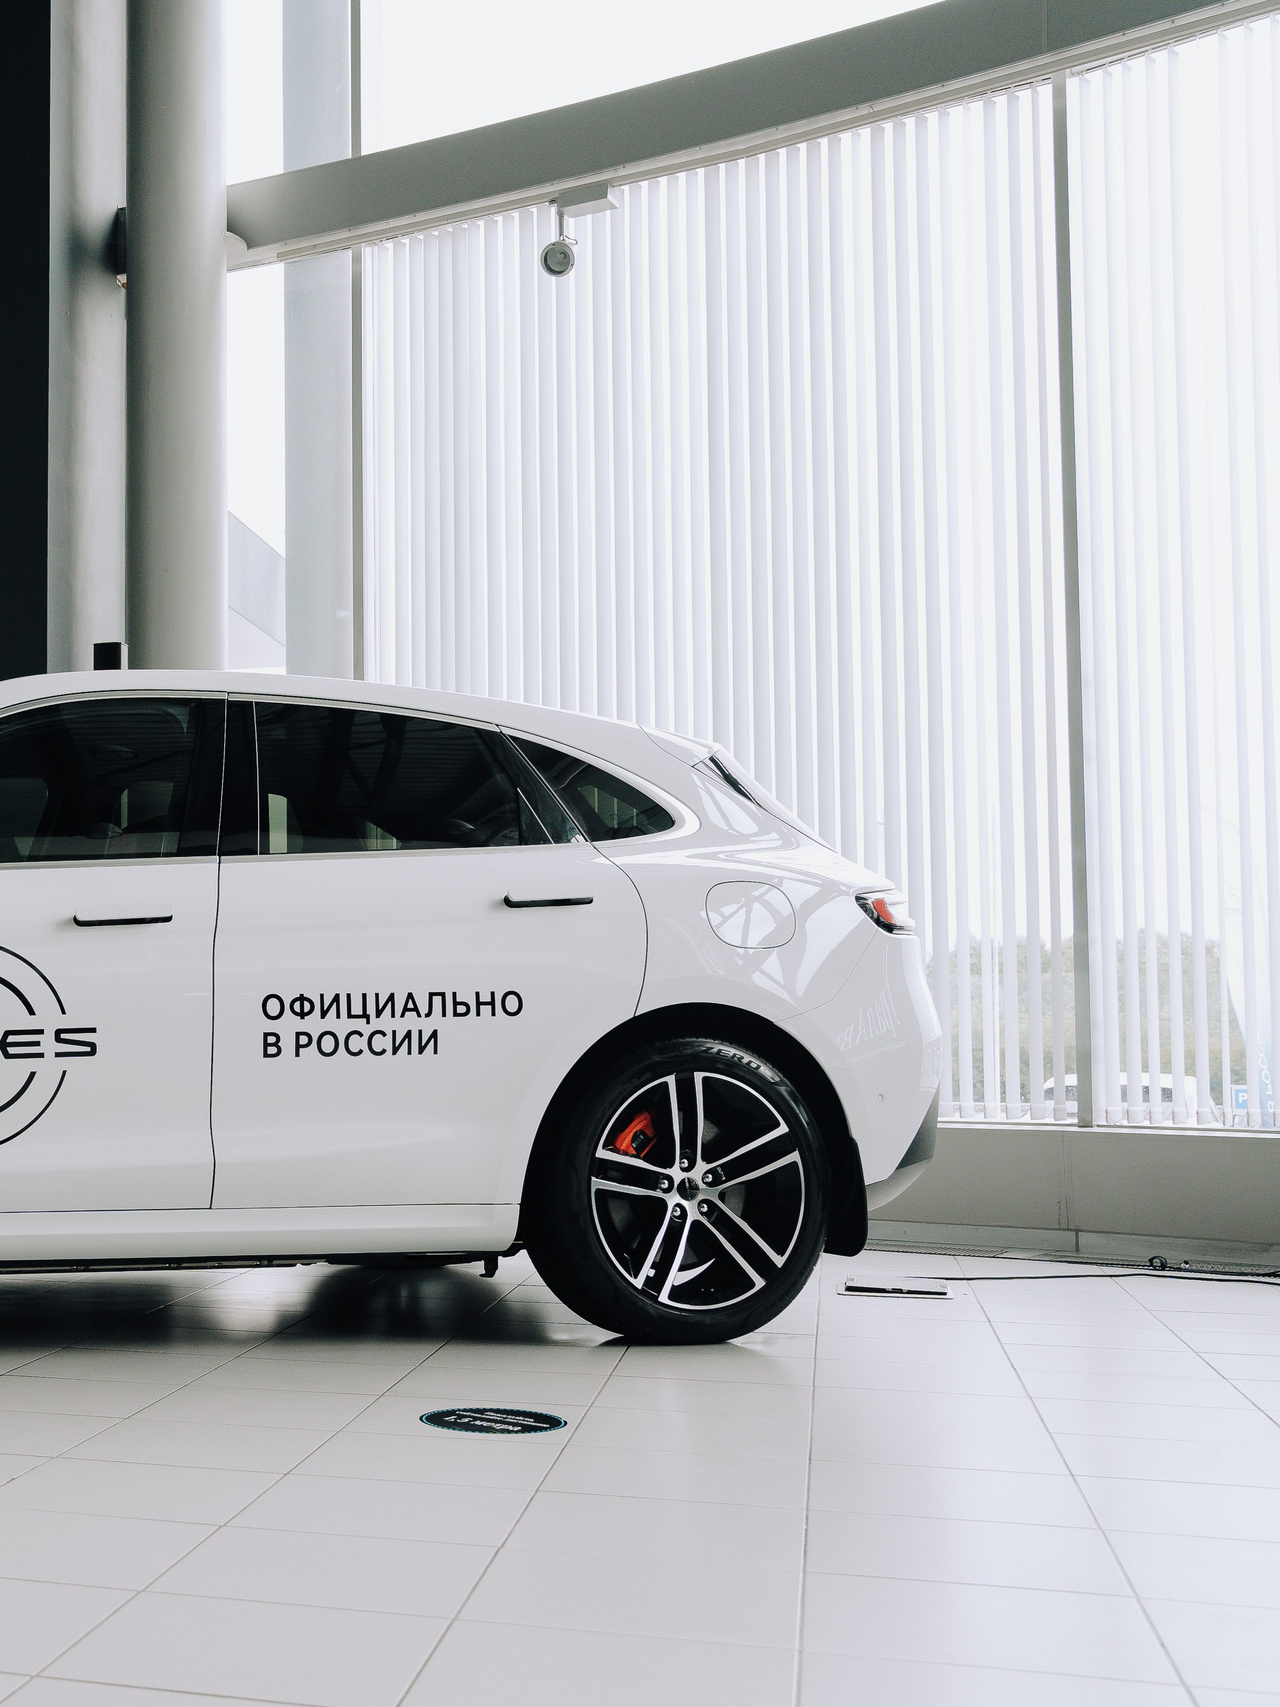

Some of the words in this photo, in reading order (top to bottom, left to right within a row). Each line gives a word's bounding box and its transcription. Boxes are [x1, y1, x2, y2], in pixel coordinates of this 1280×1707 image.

[261, 990, 524, 1024] ОФИЦИАЛЬНО
[262, 1031, 283, 1059] В
[294, 1028, 439, 1058] РОССИИ
[700, 1045, 762, 1071] ZERO
